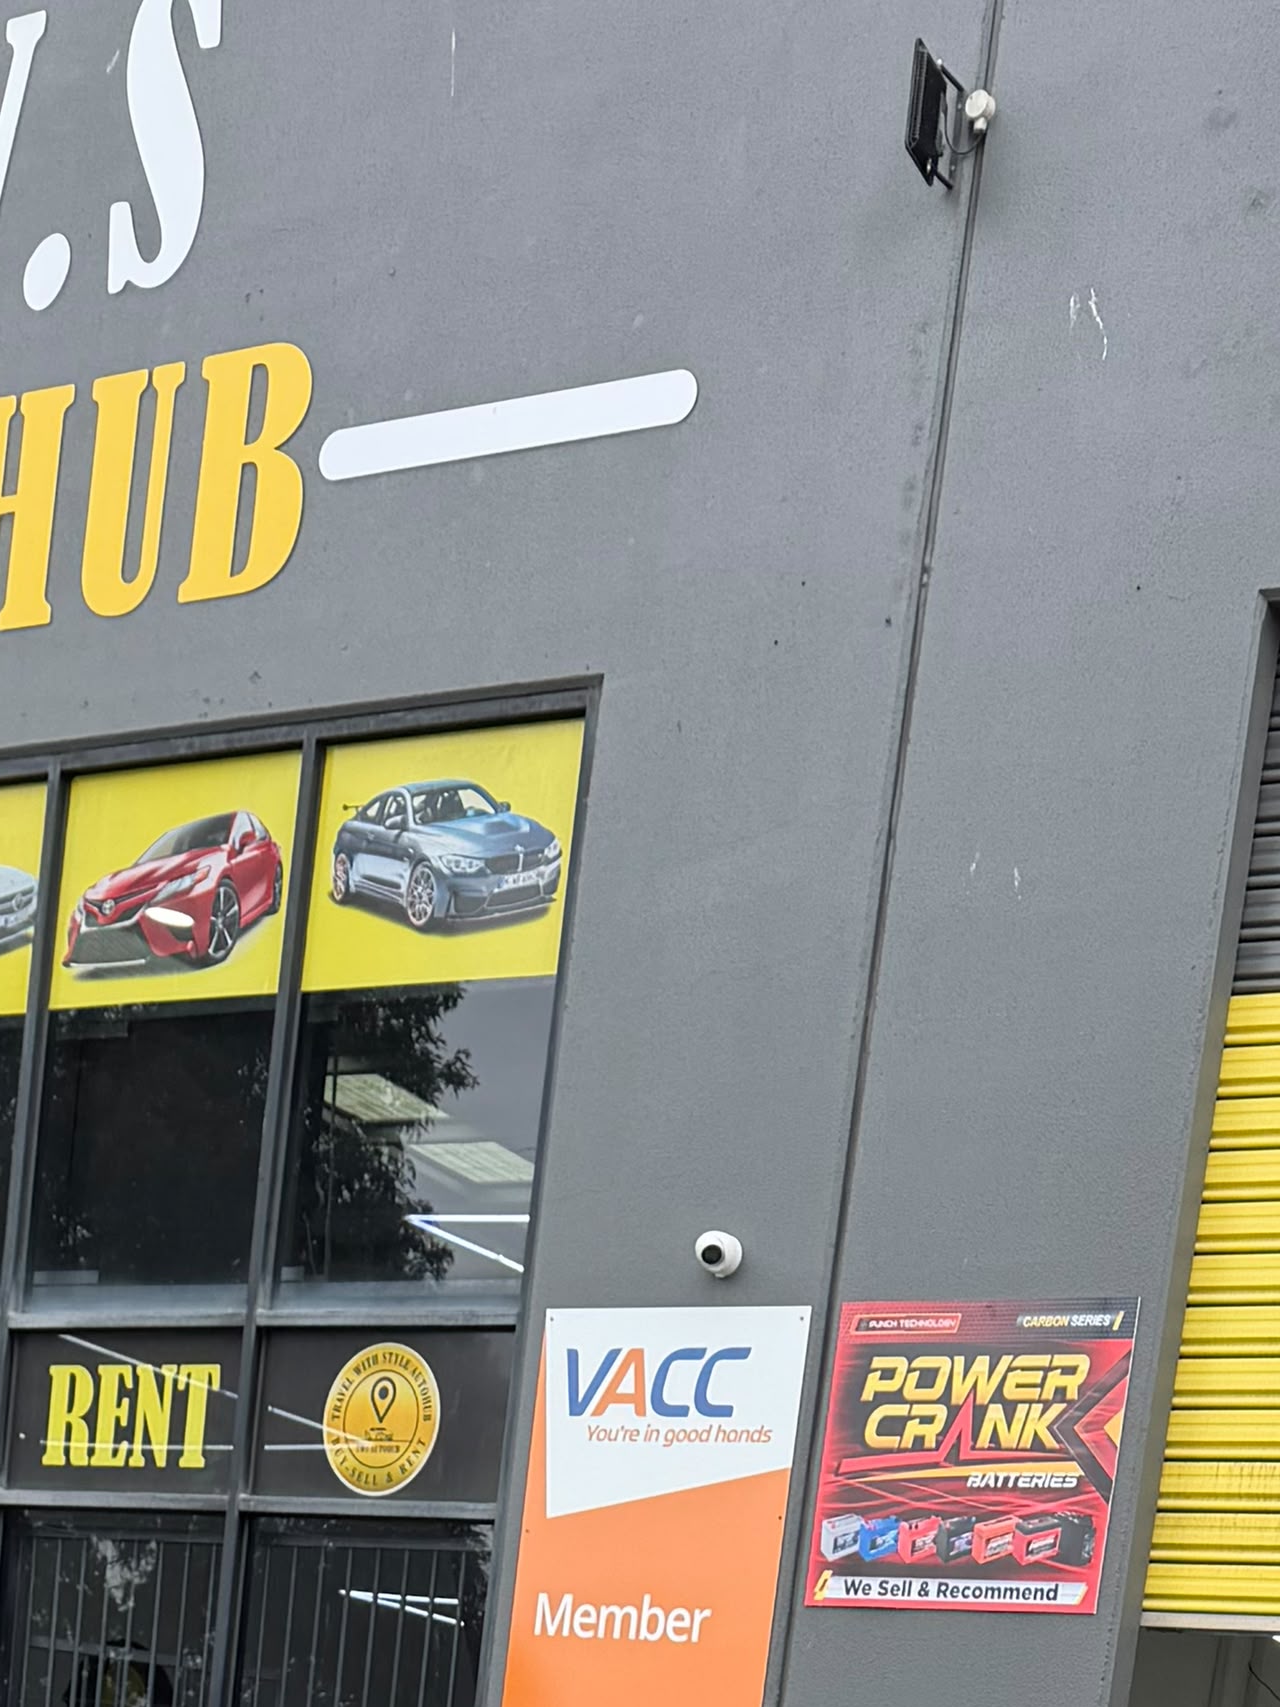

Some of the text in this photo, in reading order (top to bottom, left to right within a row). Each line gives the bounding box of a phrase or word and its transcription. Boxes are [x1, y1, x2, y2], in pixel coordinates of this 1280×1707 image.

[1022, 1313, 1111, 1328] CARBON SERIES
[567, 1346, 752, 1418] VACC
[860, 1354, 1091, 1405] POWER
[41, 1364, 221, 1468] RENT
[587, 1424, 772, 1447] You're in good hands
[864, 1398, 1068, 1454] CRANK
[967, 1472, 1078, 1488] BATTERIES
[844, 1579, 1059, 1601] We Sell & Recommend
[533, 1591, 712, 1643] Member
